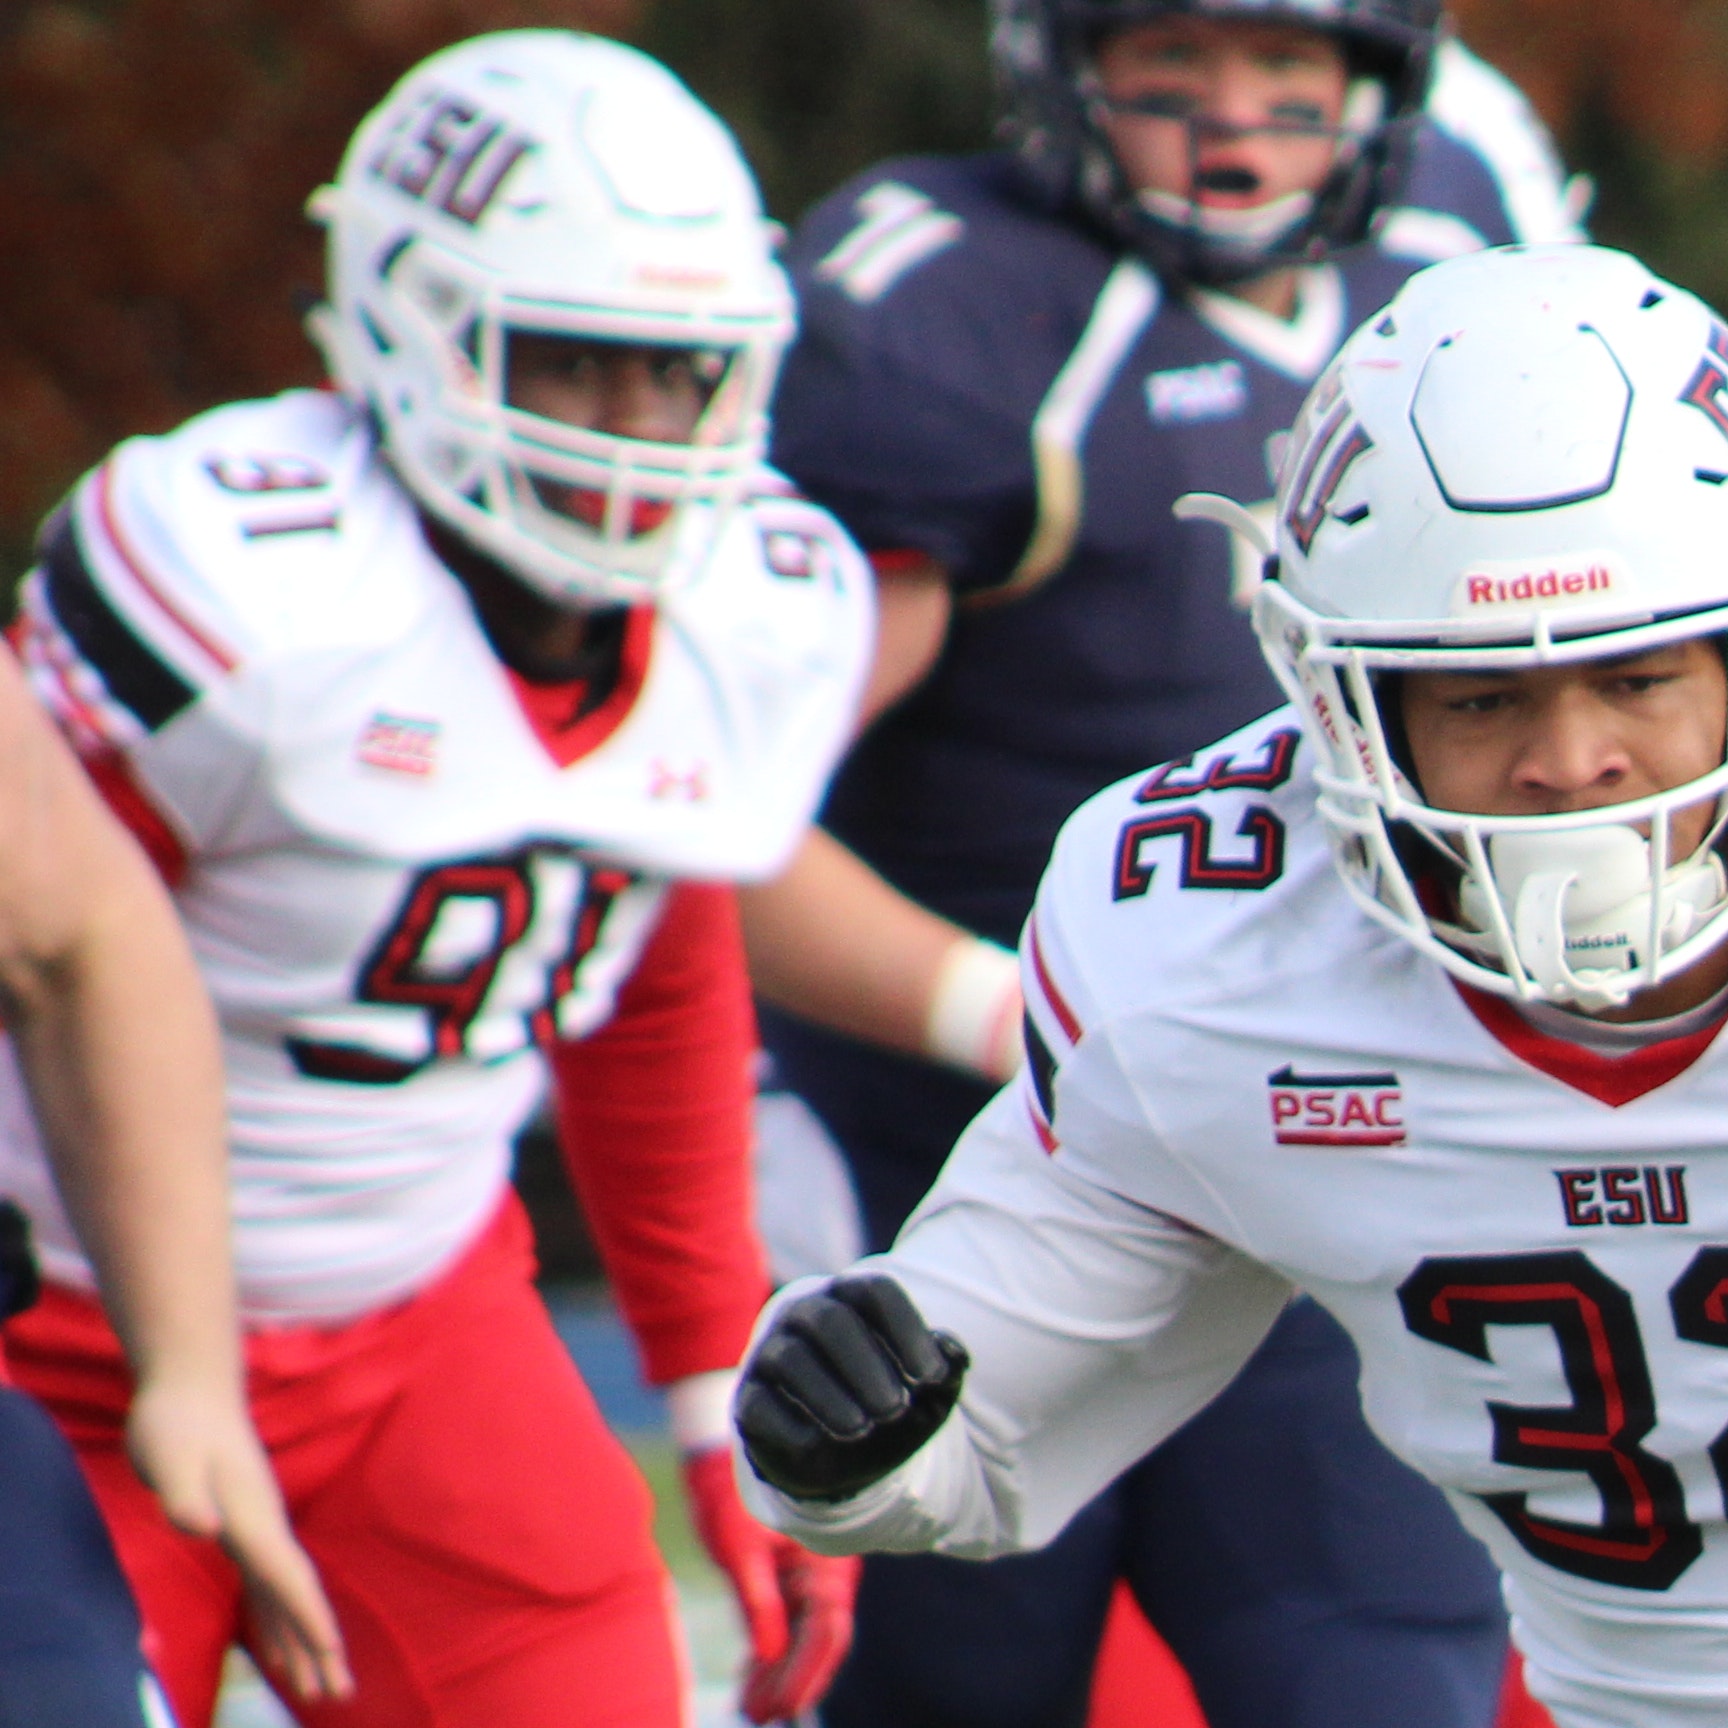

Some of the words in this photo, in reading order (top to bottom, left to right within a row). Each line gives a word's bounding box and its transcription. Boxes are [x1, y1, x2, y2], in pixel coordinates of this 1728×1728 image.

[202, 453, 348, 542] 91
[1466, 563, 1611, 606] Riddell
[1112, 725, 1304, 904] 32
[283, 835, 642, 1086] 91
[1272, 1086, 1404, 1129] PSAC
[1551, 1164, 1689, 1227] ESU
